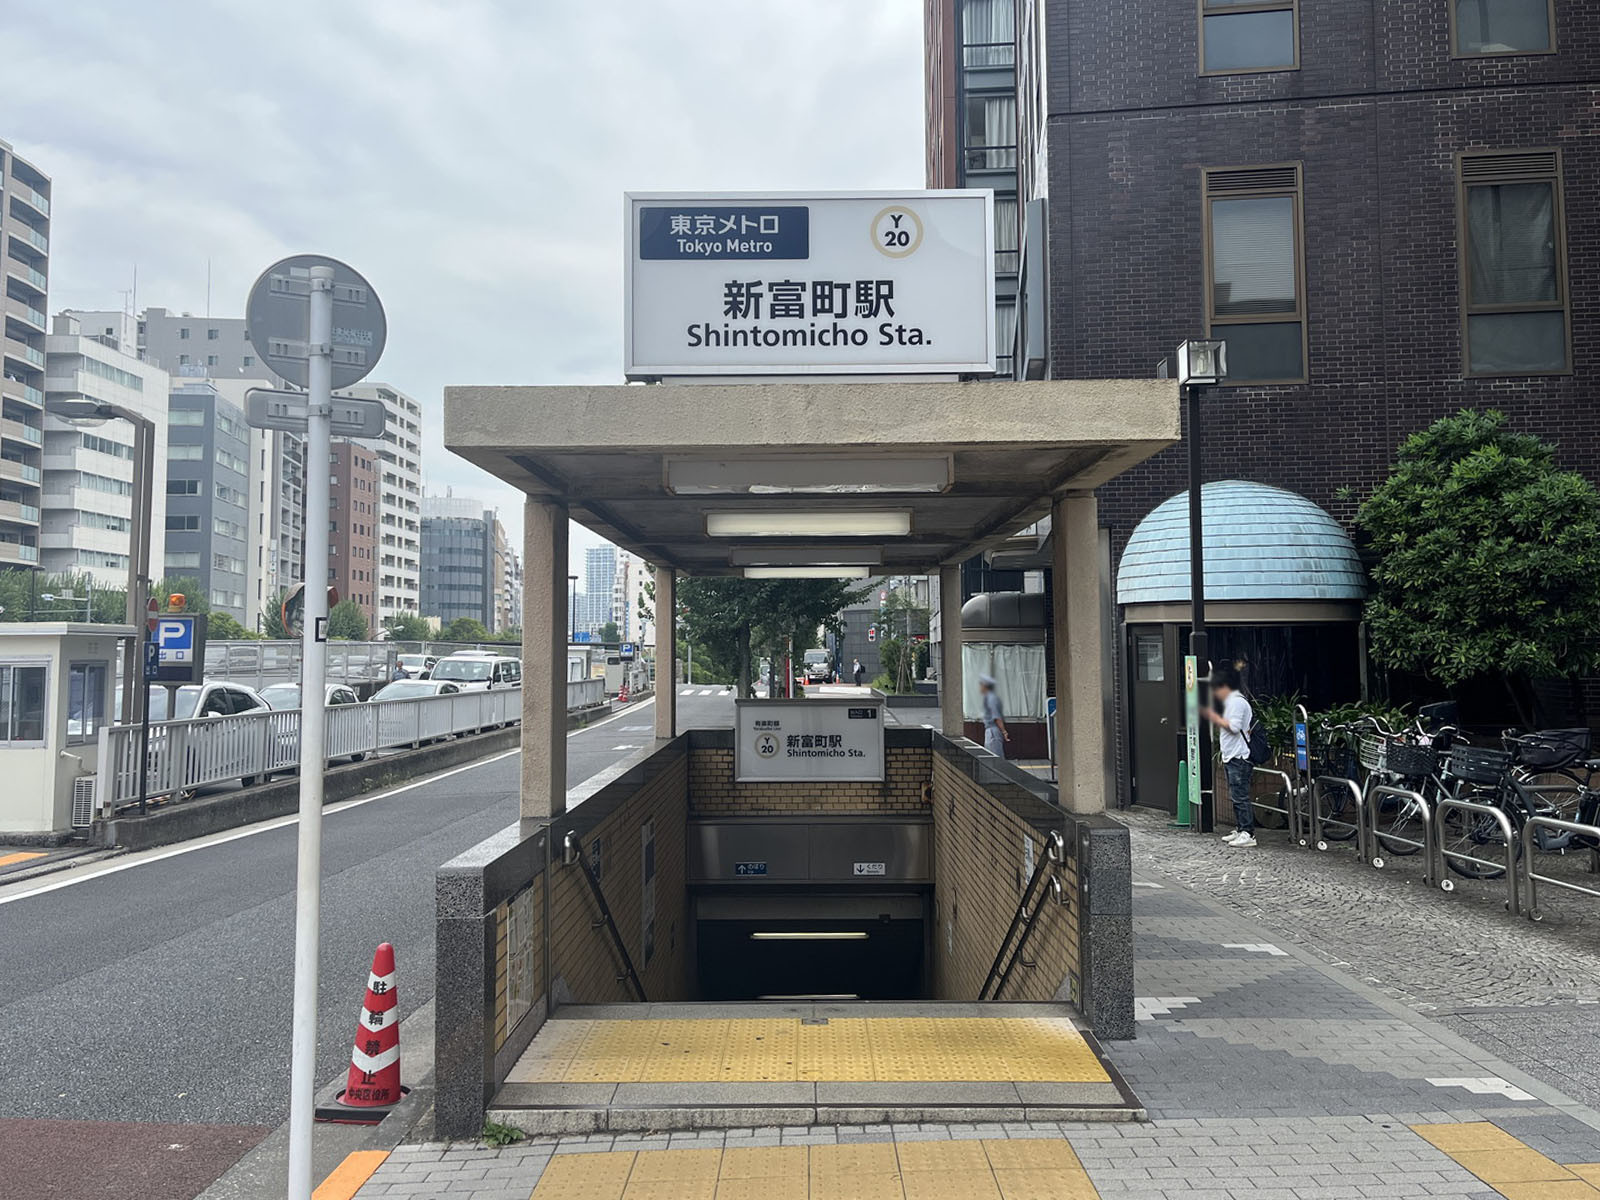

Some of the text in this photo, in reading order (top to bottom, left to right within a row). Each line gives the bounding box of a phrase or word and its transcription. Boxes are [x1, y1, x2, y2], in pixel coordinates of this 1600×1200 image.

[670, 215, 780, 235] 東京メトロ
[891, 214, 903, 229] Y
[884, 231, 910, 247] 20
[677, 239, 773, 257] Tokyo Metro
[723, 280, 895, 319] 新富町駅
[688, 323, 933, 347] Shintomicho Sta.
[160, 622, 185, 646] P
[148, 645, 155, 662] P
[623, 644, 631, 652] P
[867, 710, 872, 718] 1
[761, 745, 774, 753] 20
[787, 734, 842, 748] 新富町駅
[787, 748, 866, 757] Shintomicho Sta.
